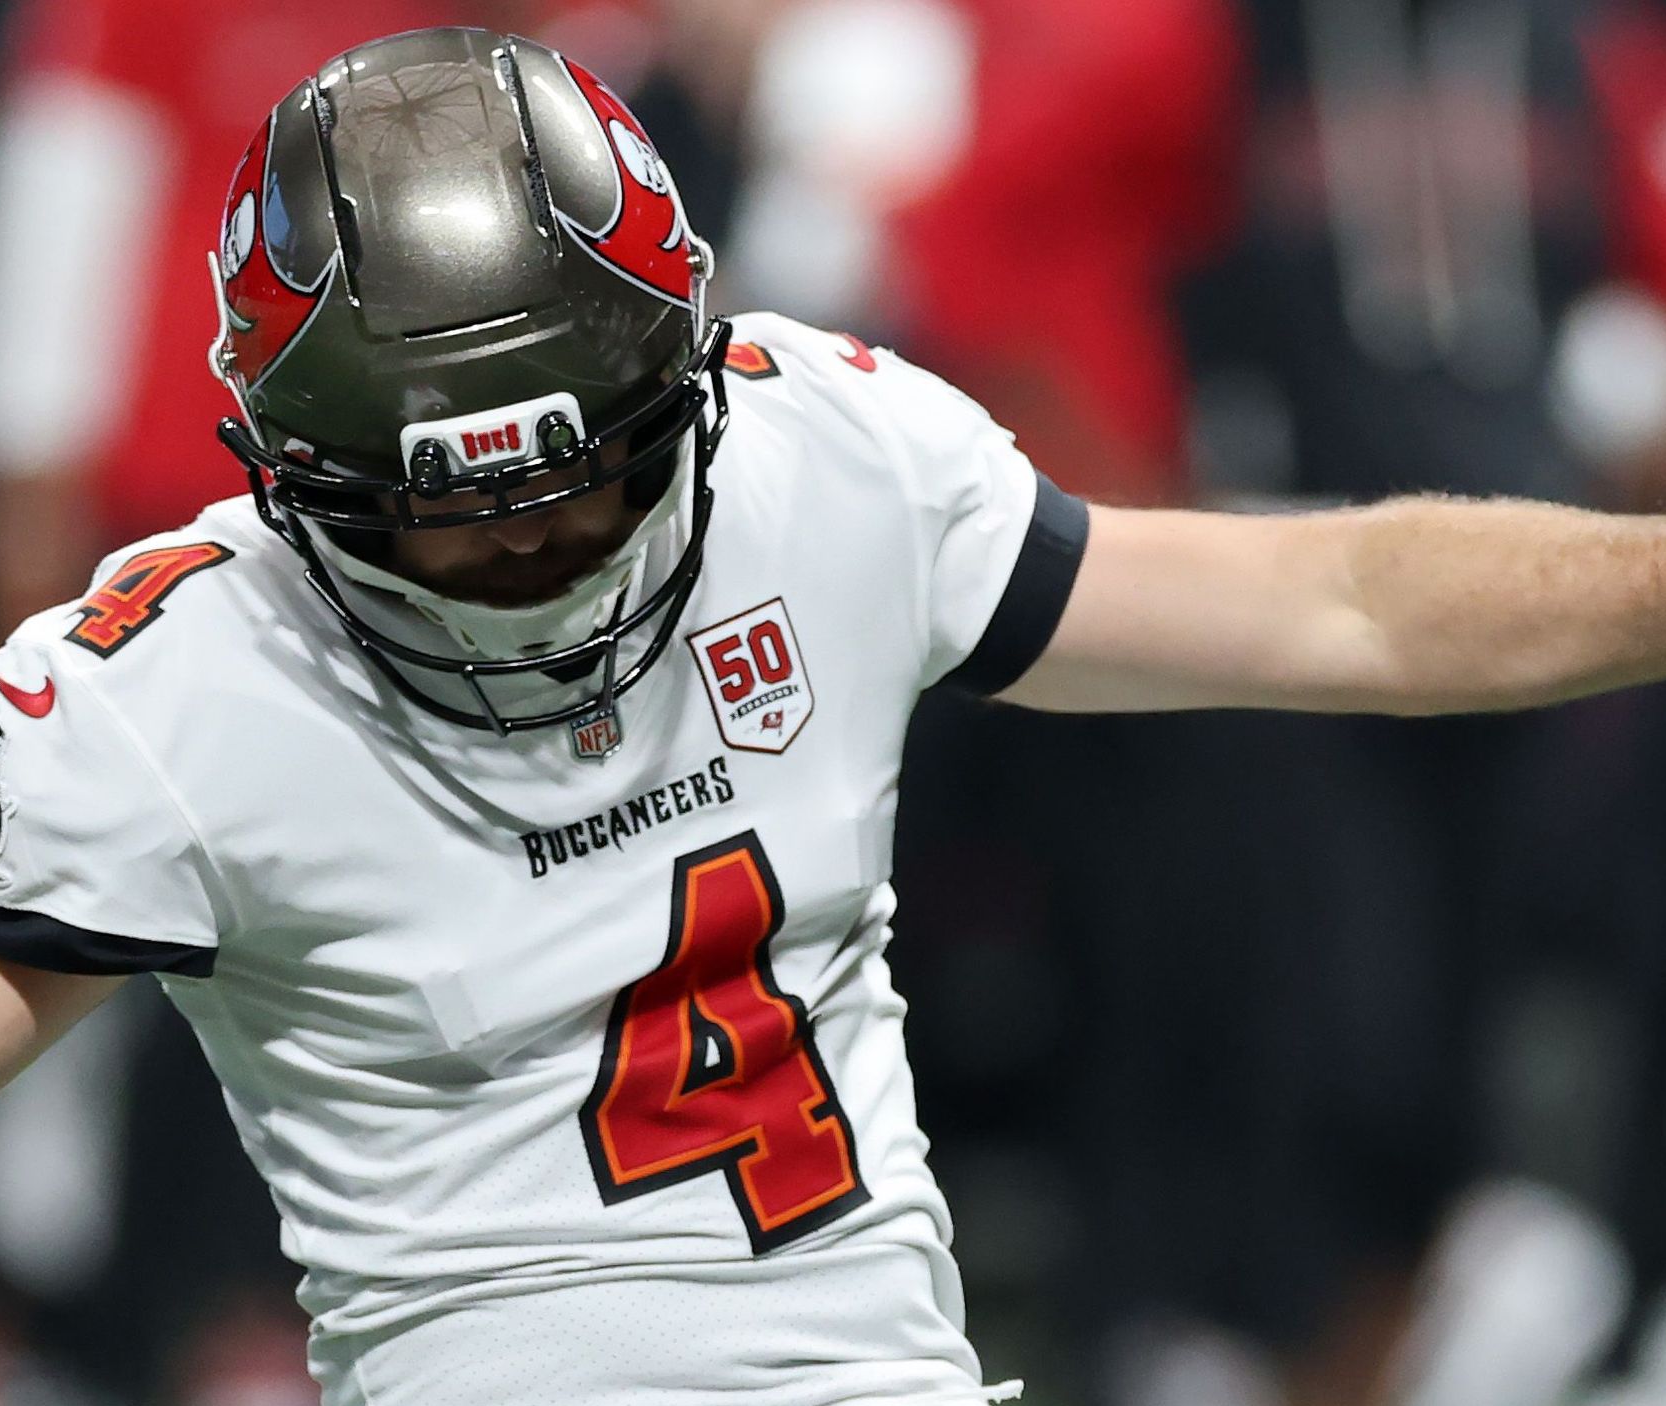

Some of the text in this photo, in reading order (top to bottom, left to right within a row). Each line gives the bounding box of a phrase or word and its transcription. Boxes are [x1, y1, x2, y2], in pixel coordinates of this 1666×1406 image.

[64, 541, 237, 660] 4
[706, 620, 793, 703] 50
[576, 721, 618, 753] NFL
[519, 755, 734, 879] BUCCANEERS
[578, 828, 874, 1256] 4
